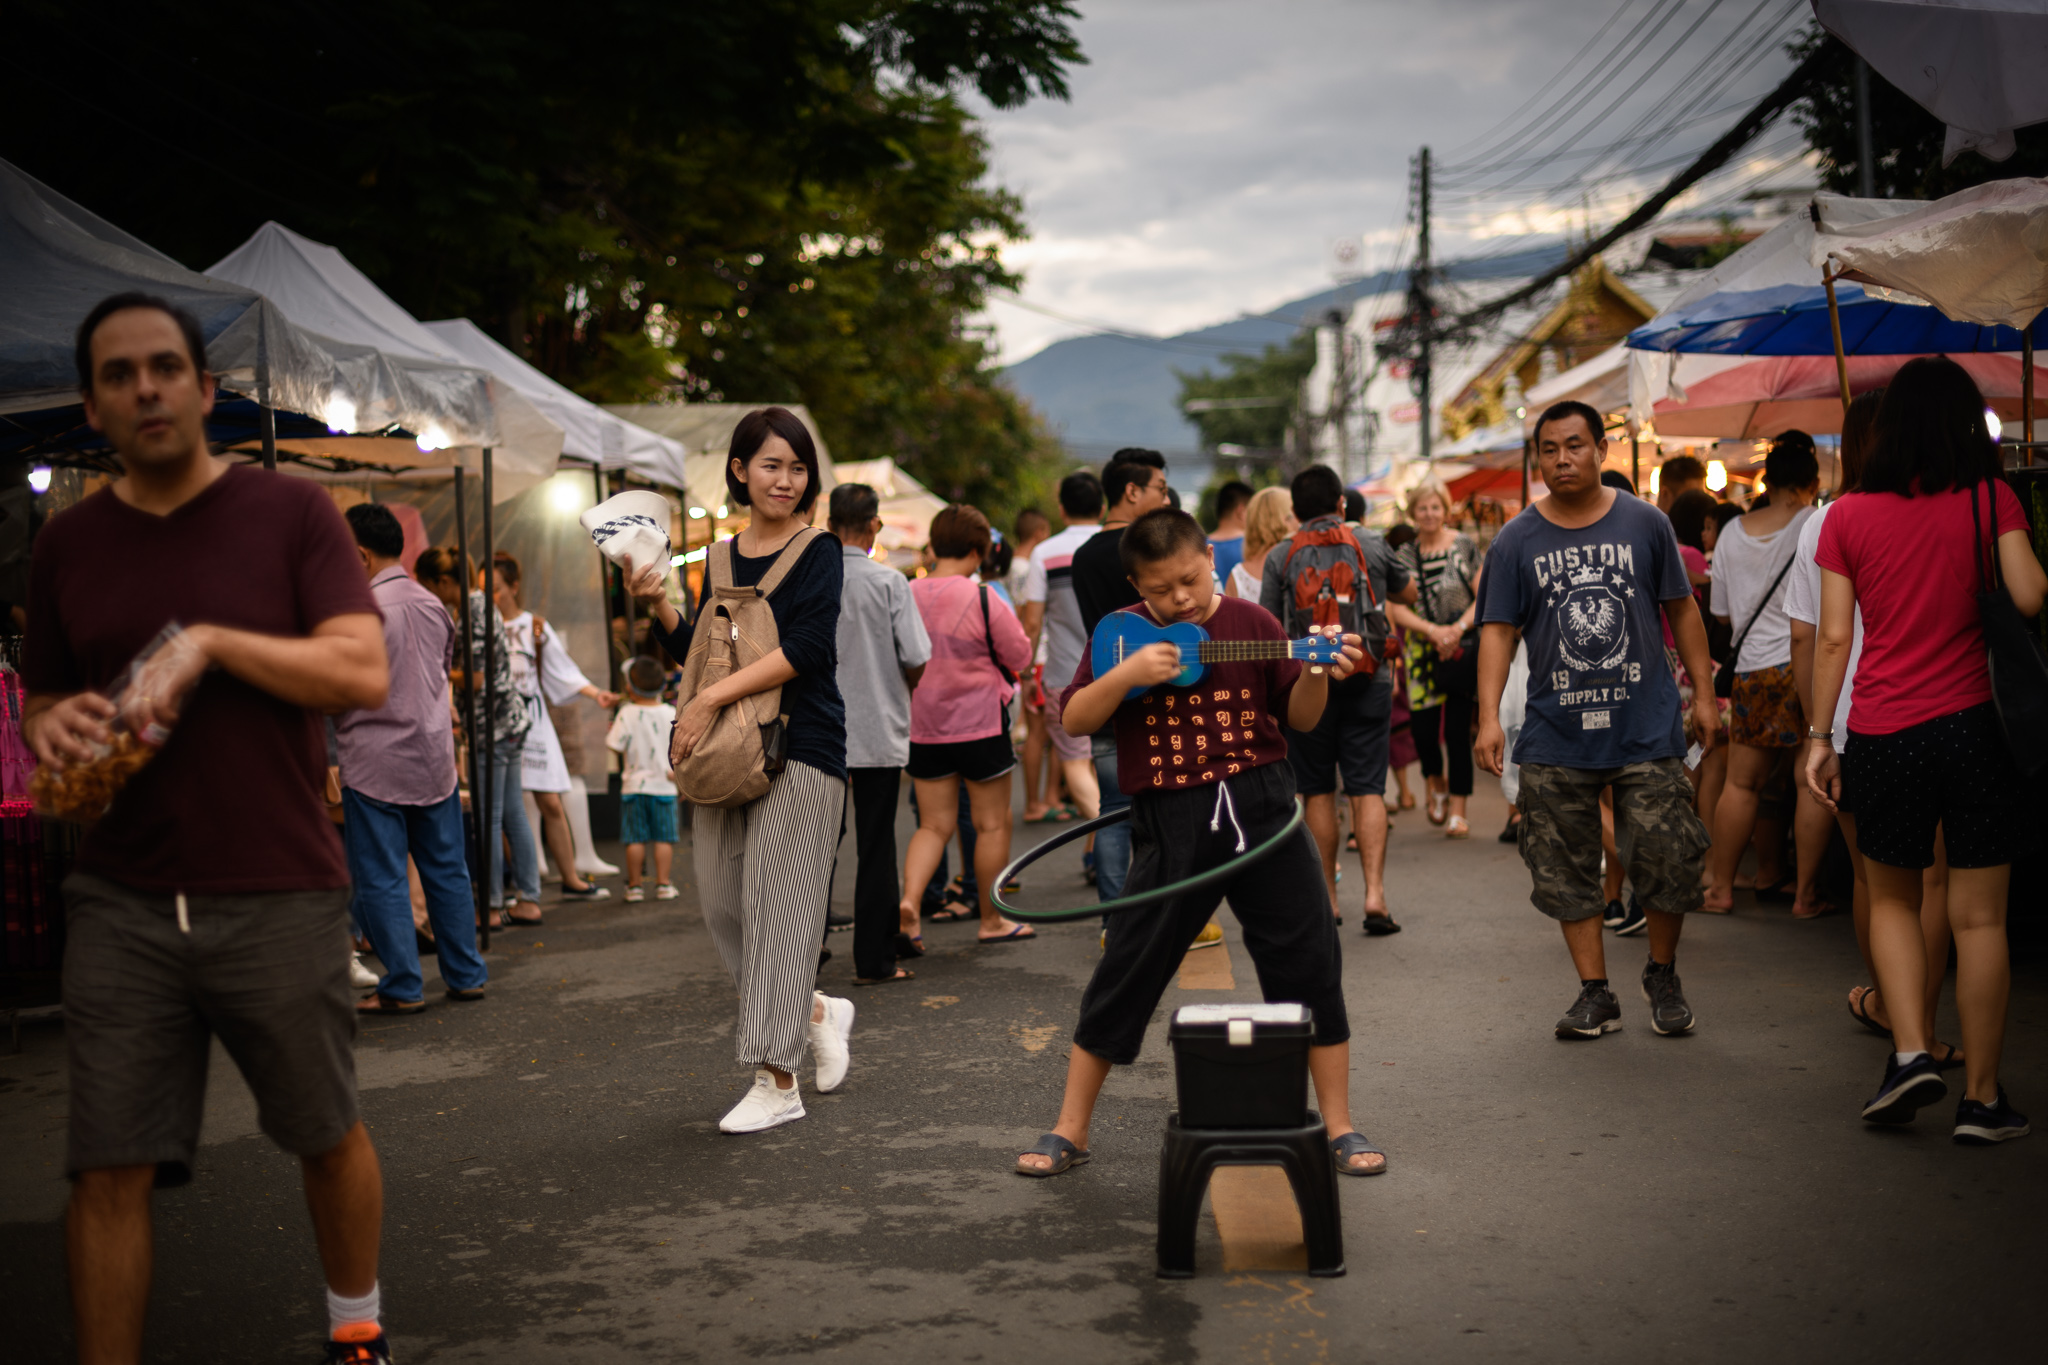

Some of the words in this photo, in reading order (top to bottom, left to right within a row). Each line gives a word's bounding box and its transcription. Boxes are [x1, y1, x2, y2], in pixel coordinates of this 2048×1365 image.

[1533, 543, 1635, 589] CUSTOM
[1551, 669, 1570, 691] 19
[1621, 662, 1642, 683] 76
[1559, 687, 1610, 706] SUPPLY
